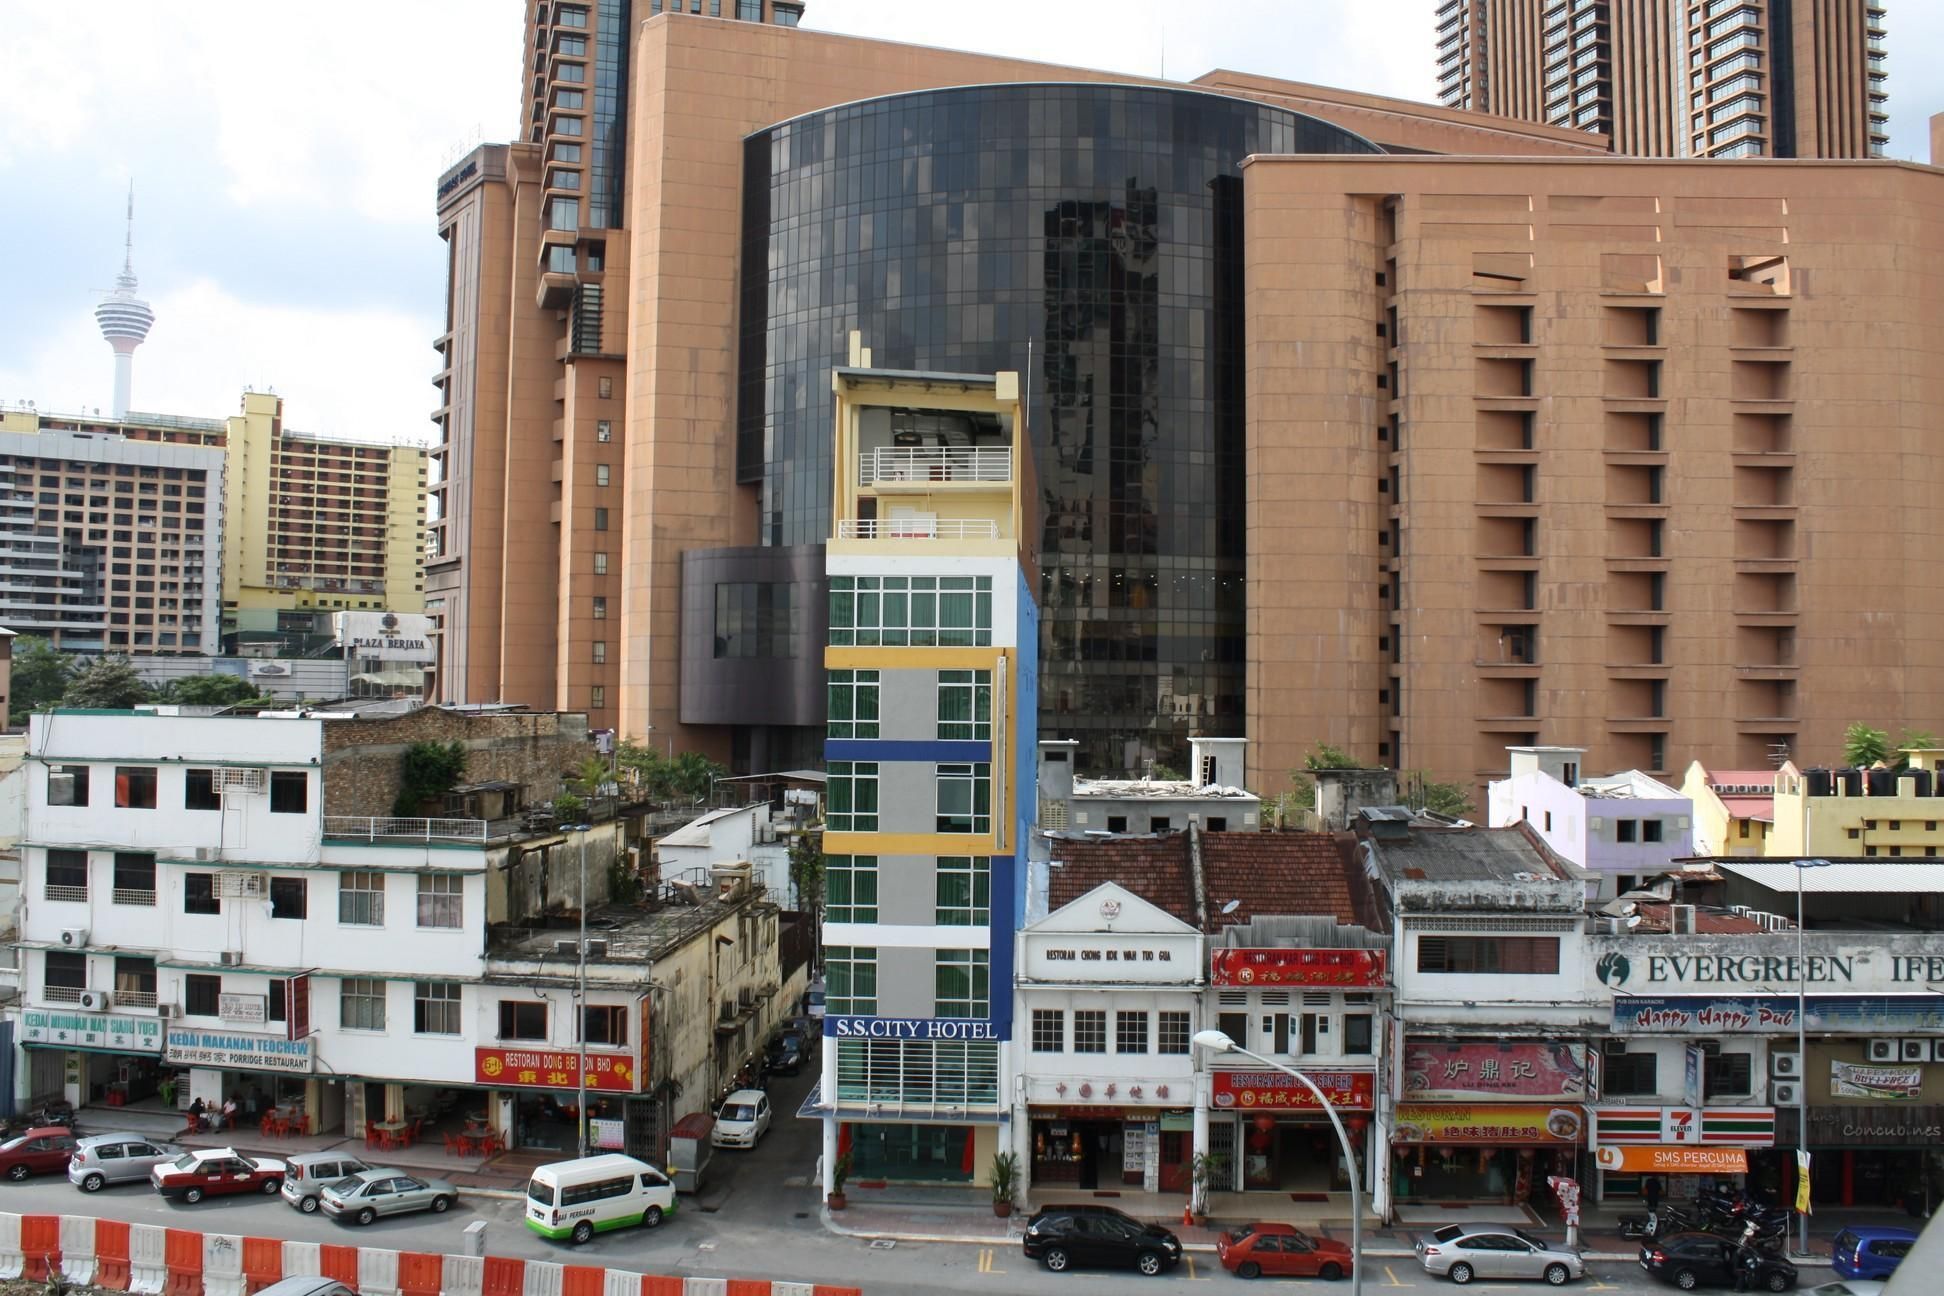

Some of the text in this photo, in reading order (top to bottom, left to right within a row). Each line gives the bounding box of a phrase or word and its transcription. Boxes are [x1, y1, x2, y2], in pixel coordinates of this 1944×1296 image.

[353, 638, 424, 650] PLAZA BERJAYA
[1046, 950, 1075, 961] RESTORAN
[1081, 950, 1101, 961] CHONG
[1106, 950, 1117, 961] KOK
[1123, 950, 1136, 961] WAH
[1142, 950, 1153, 961] TUO
[1648, 955, 1854, 982] EVERGREEN
[24, 1012, 47, 1027] KEDAI
[50, 1014, 88, 1031] MINUMAN
[1637, 1007, 1795, 1028] Happy Happy Pub
[927, 1021, 998, 1039] HOTEL
[169, 1032, 308, 1055] KEDAI MAKANAN TEOCHEW
[229, 1053, 263, 1065] PORRIDGE
[264, 1057, 308, 1069] RESTAURANT
[505, 1053, 540, 1068] RESTORAN
[544, 1054, 562, 1070] DONG
[566, 1056, 576, 1070] BEI
[597, 1058, 611, 1072] BHD
[1231, 1073, 1274, 1088] RESTORAN
[1318, 1074, 1335, 1088] SDN
[1335, 1074, 1353, 1088] BHD
[1398, 1107, 1472, 1121] RESTORAN
[1671, 1112, 1692, 1140] 7
[1654, 1151, 1745, 1164] SMS PERCUMA
